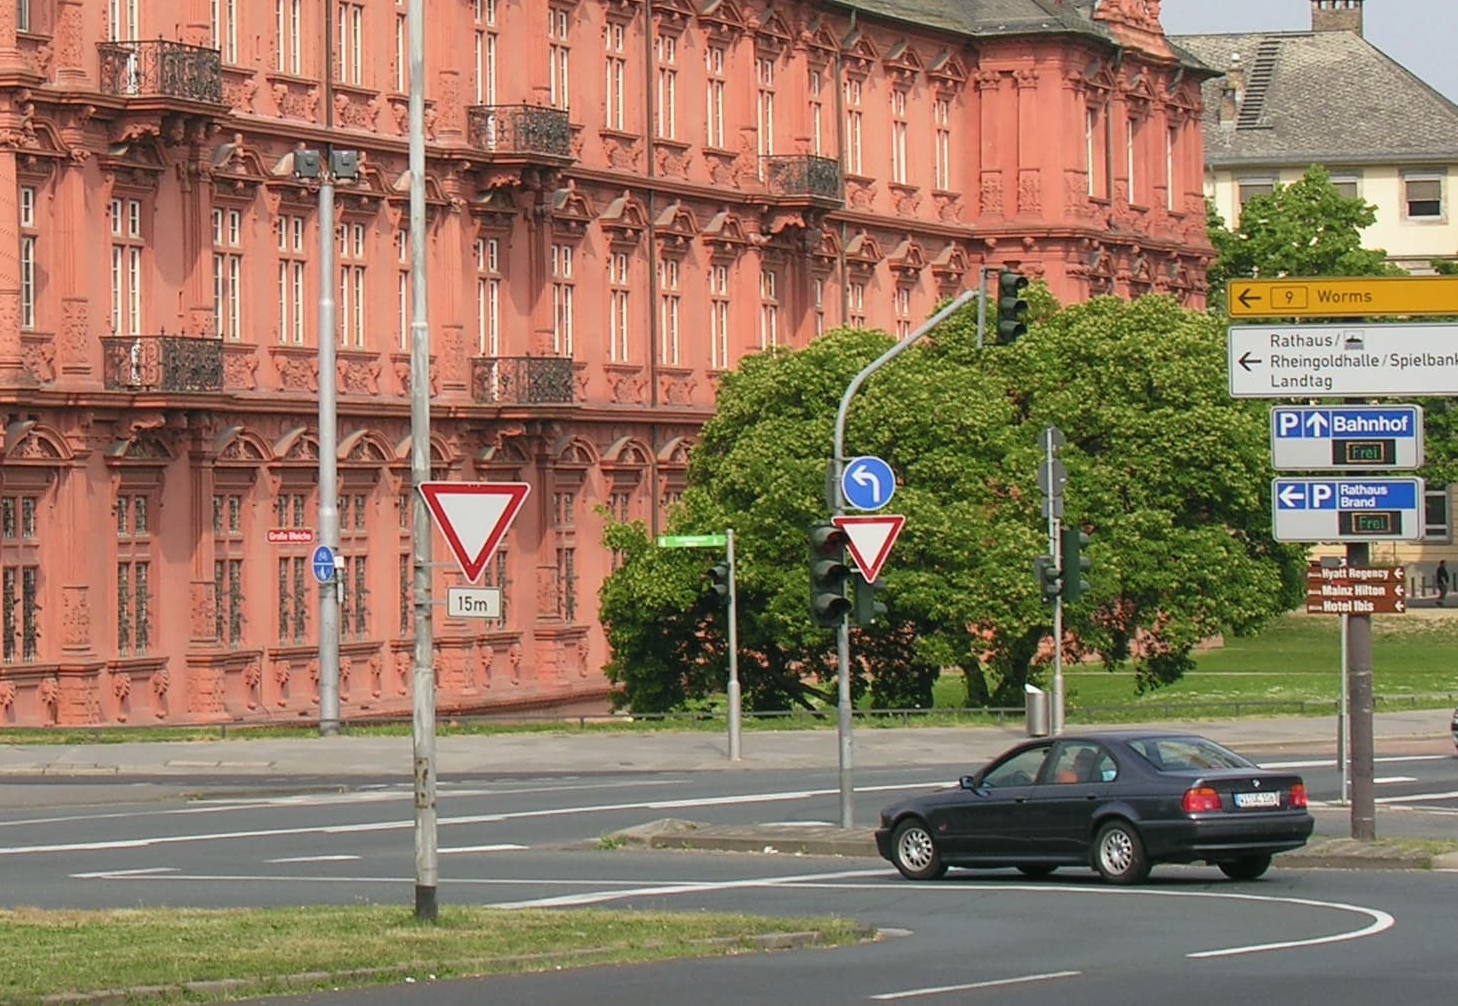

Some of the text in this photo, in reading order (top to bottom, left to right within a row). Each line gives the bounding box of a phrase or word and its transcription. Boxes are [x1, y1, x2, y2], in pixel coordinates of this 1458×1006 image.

[1285, 290, 1373, 304] 9 Worms
[1271, 375, 1333, 391] Landtag
[1280, 413, 1408, 436] P Bahnhof
[1352, 445, 1378, 459] Frei
[1312, 484, 1332, 508] P
[1340, 484, 1388, 496] Rathaus
[1340, 496, 1376, 508] Brand
[1358, 516, 1385, 530] Frei
[288, 531, 312, 541] Bleiche
[1322, 568, 1389, 581] Hyatt Regency
[1322, 584, 1386, 597] Mainz Hilton
[1323, 600, 1353, 612] Hotel
[1353, 599, 1375, 612] Ibis
